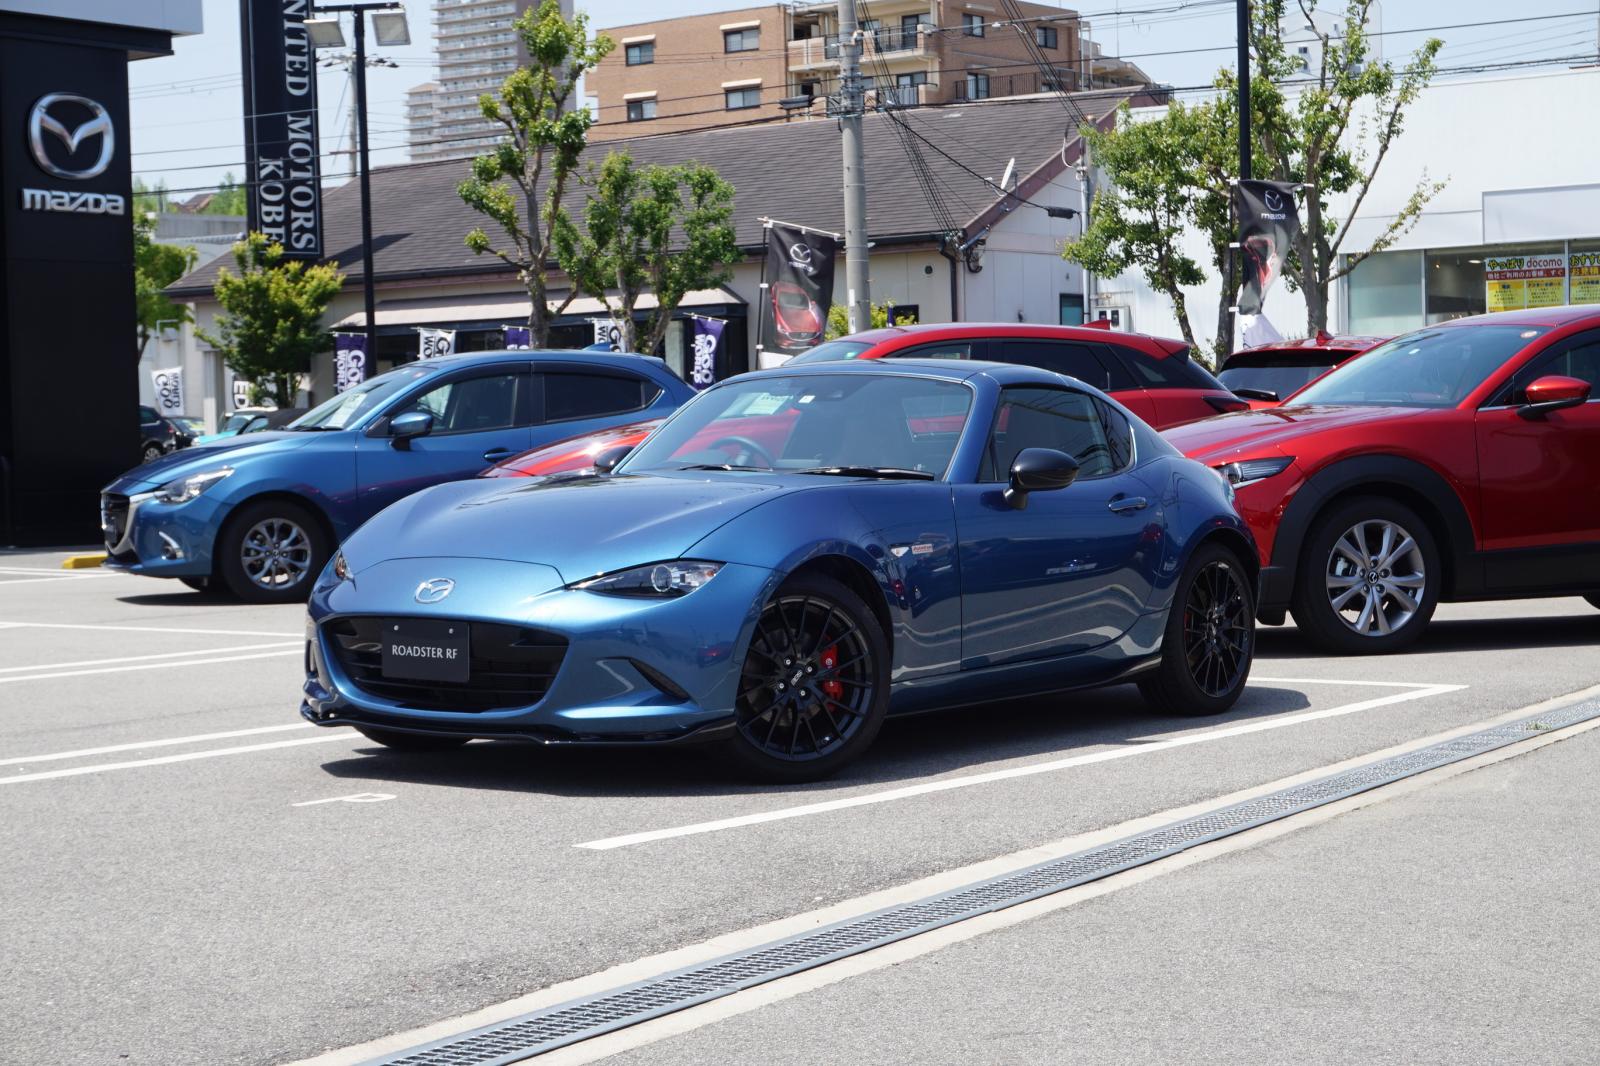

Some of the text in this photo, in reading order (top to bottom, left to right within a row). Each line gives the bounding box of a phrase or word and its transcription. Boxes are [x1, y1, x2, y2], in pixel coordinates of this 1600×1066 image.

[259, 156, 286, 245] KOBE
[287, 114, 316, 249] MOTORS
[1527, 257, 1562, 268] docomo
[391, 644, 458, 659] ROADSTER RF
